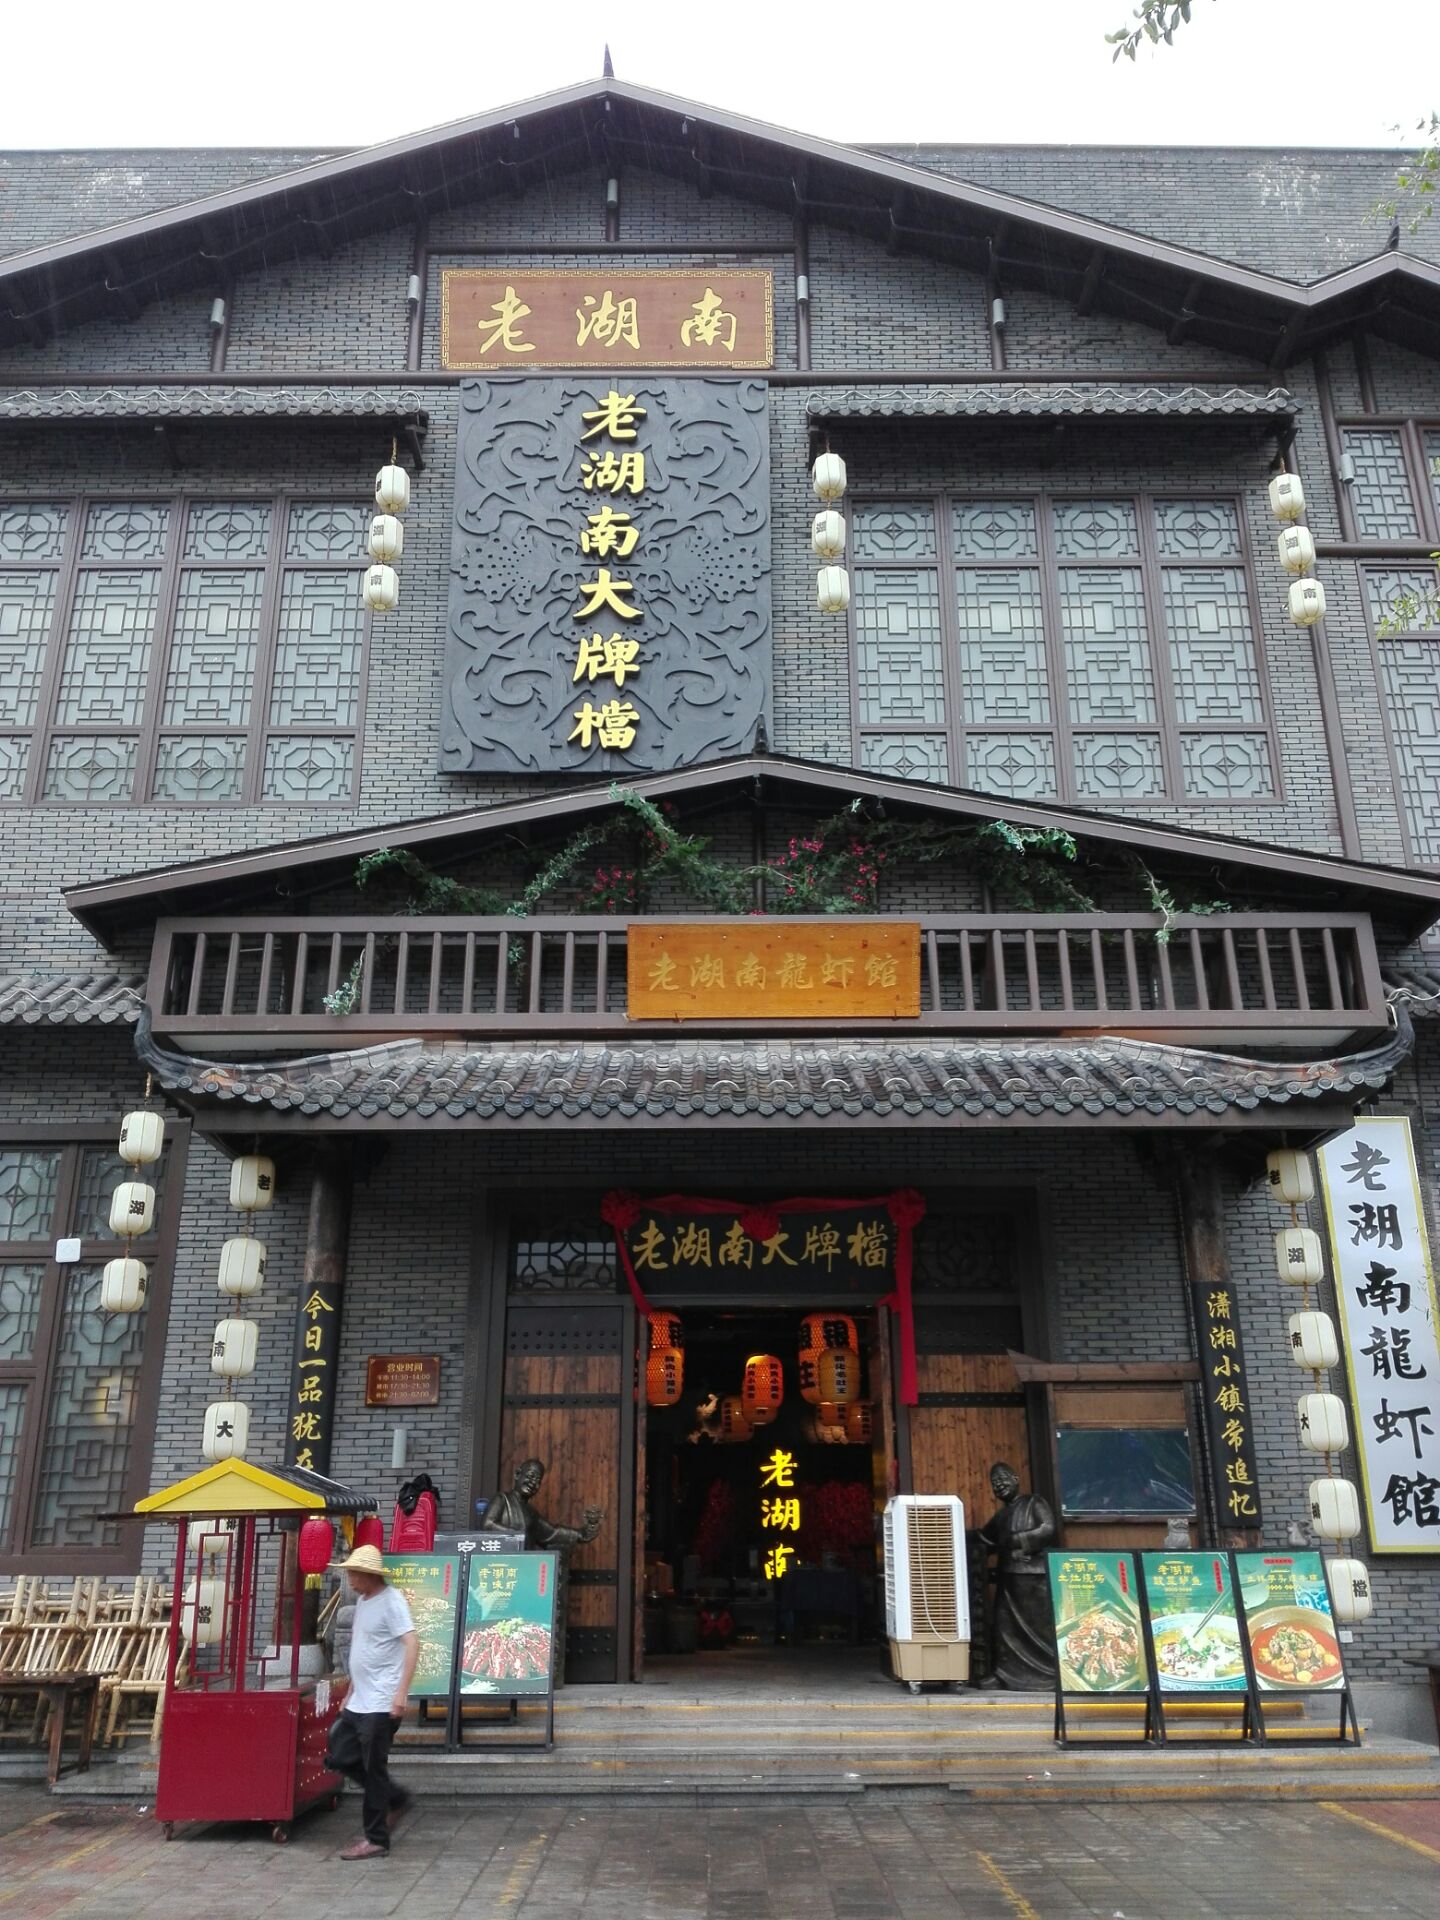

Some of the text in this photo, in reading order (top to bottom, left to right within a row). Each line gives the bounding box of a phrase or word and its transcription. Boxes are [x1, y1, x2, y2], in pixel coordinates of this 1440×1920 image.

[477, 285, 738, 355] 老湖南
[567, 389, 647, 751] 老湖南大牌檔
[648, 952, 900, 991] 老湖南龍虾館
[633, 1219, 888, 1273] 老湖南大牌檔
[1339, 1140, 1440, 1529] 老湖南龍虾館
[387, 1363, 422, 1372] 营业时间
